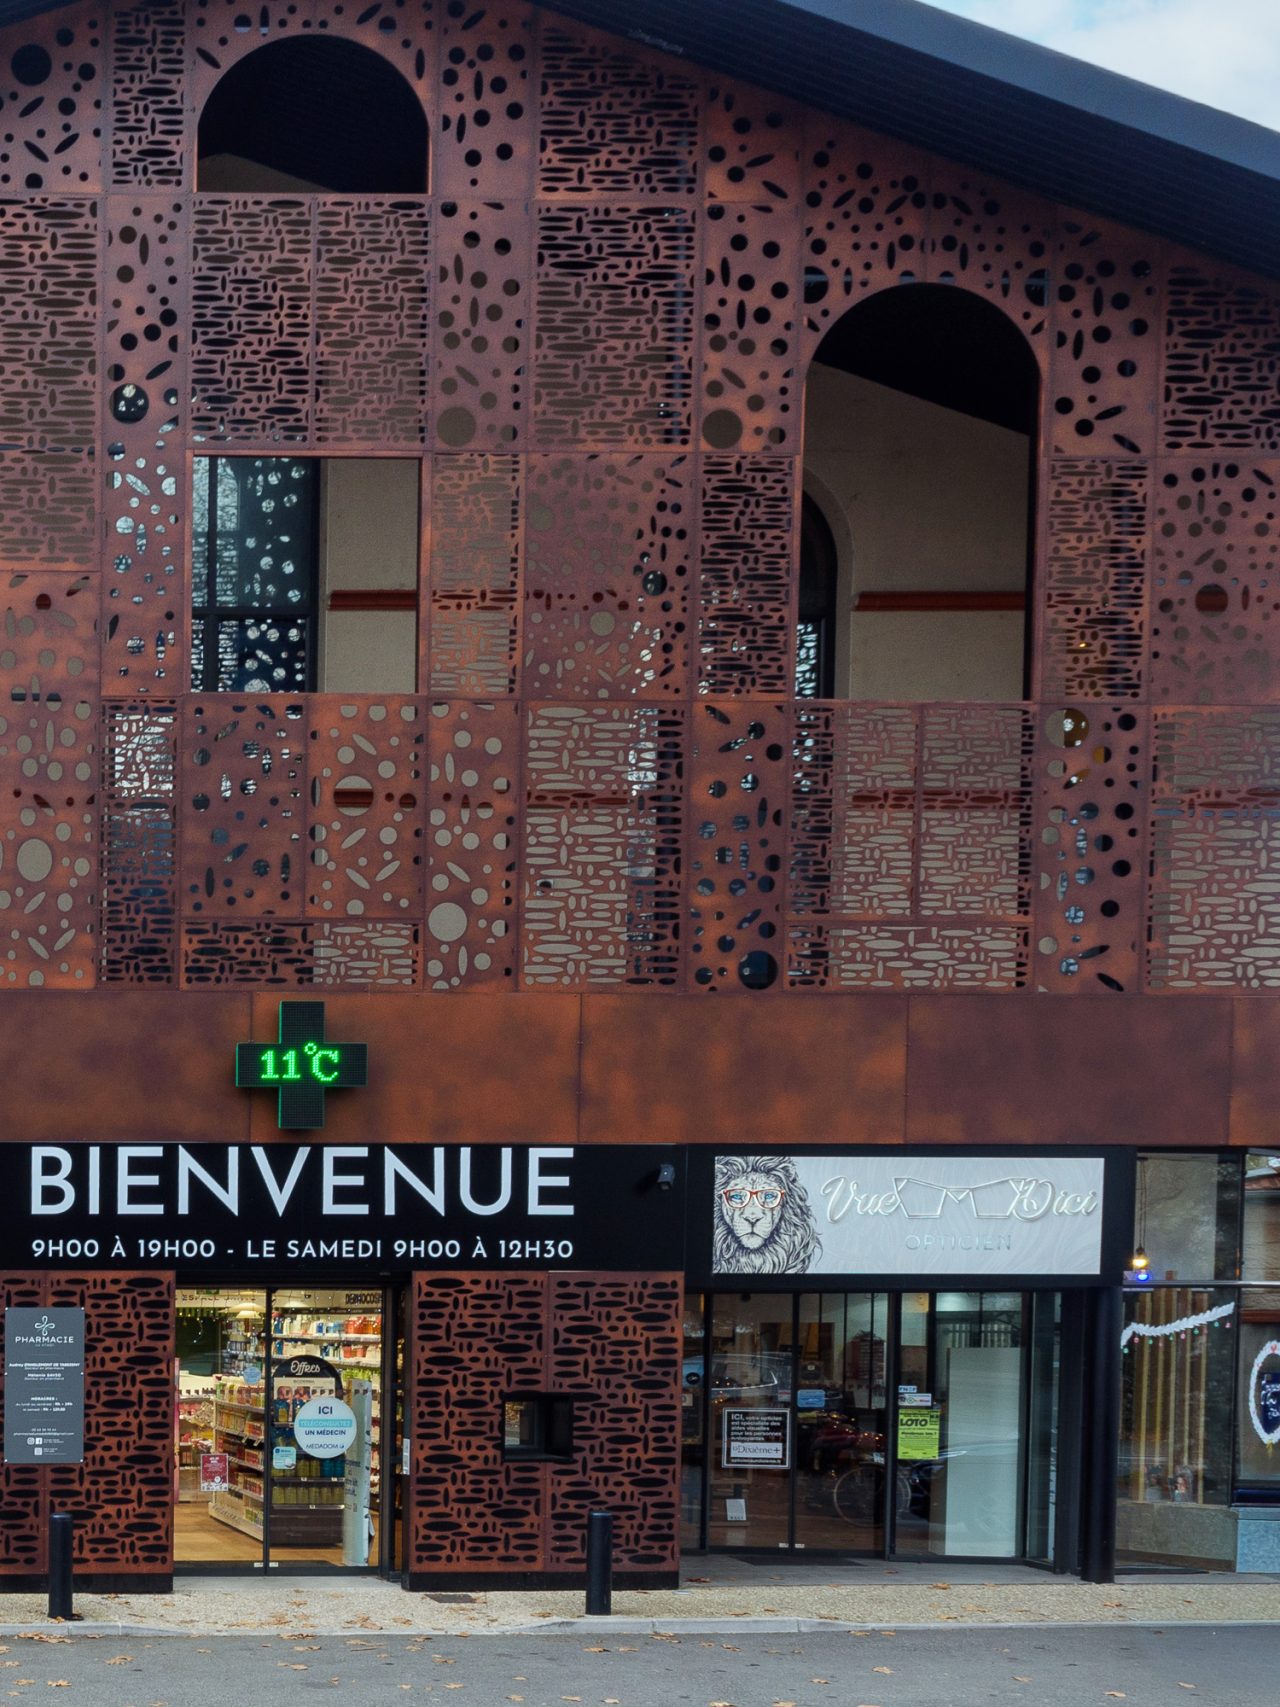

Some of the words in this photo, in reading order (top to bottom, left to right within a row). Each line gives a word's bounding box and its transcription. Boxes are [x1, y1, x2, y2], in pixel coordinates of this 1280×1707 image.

[260, 1042, 339, 1082] 11°C
[30, 1146, 575, 1217] BIENVENUE
[31, 1239, 100, 1259] 9H00
[110, 1235, 127, 1259] À
[137, 1239, 216, 1259] 19H00
[246, 1239, 277, 1259] LE
[287, 1240, 382, 1259] SAMEDI
[393, 1240, 461, 1259] 9H00
[472, 1236, 489, 1259] À
[498, 1240, 574, 1260] 12H30
[905, 1233, 1012, 1251] OPTICIEN
[15, 1335, 75, 1344] PHARMACIE
[290, 1361, 320, 1375] Offres
[318, 1406, 333, 1415] ICI
[900, 1418, 928, 1427] LOTO
[316, 1428, 346, 1436] MÉDECIN
